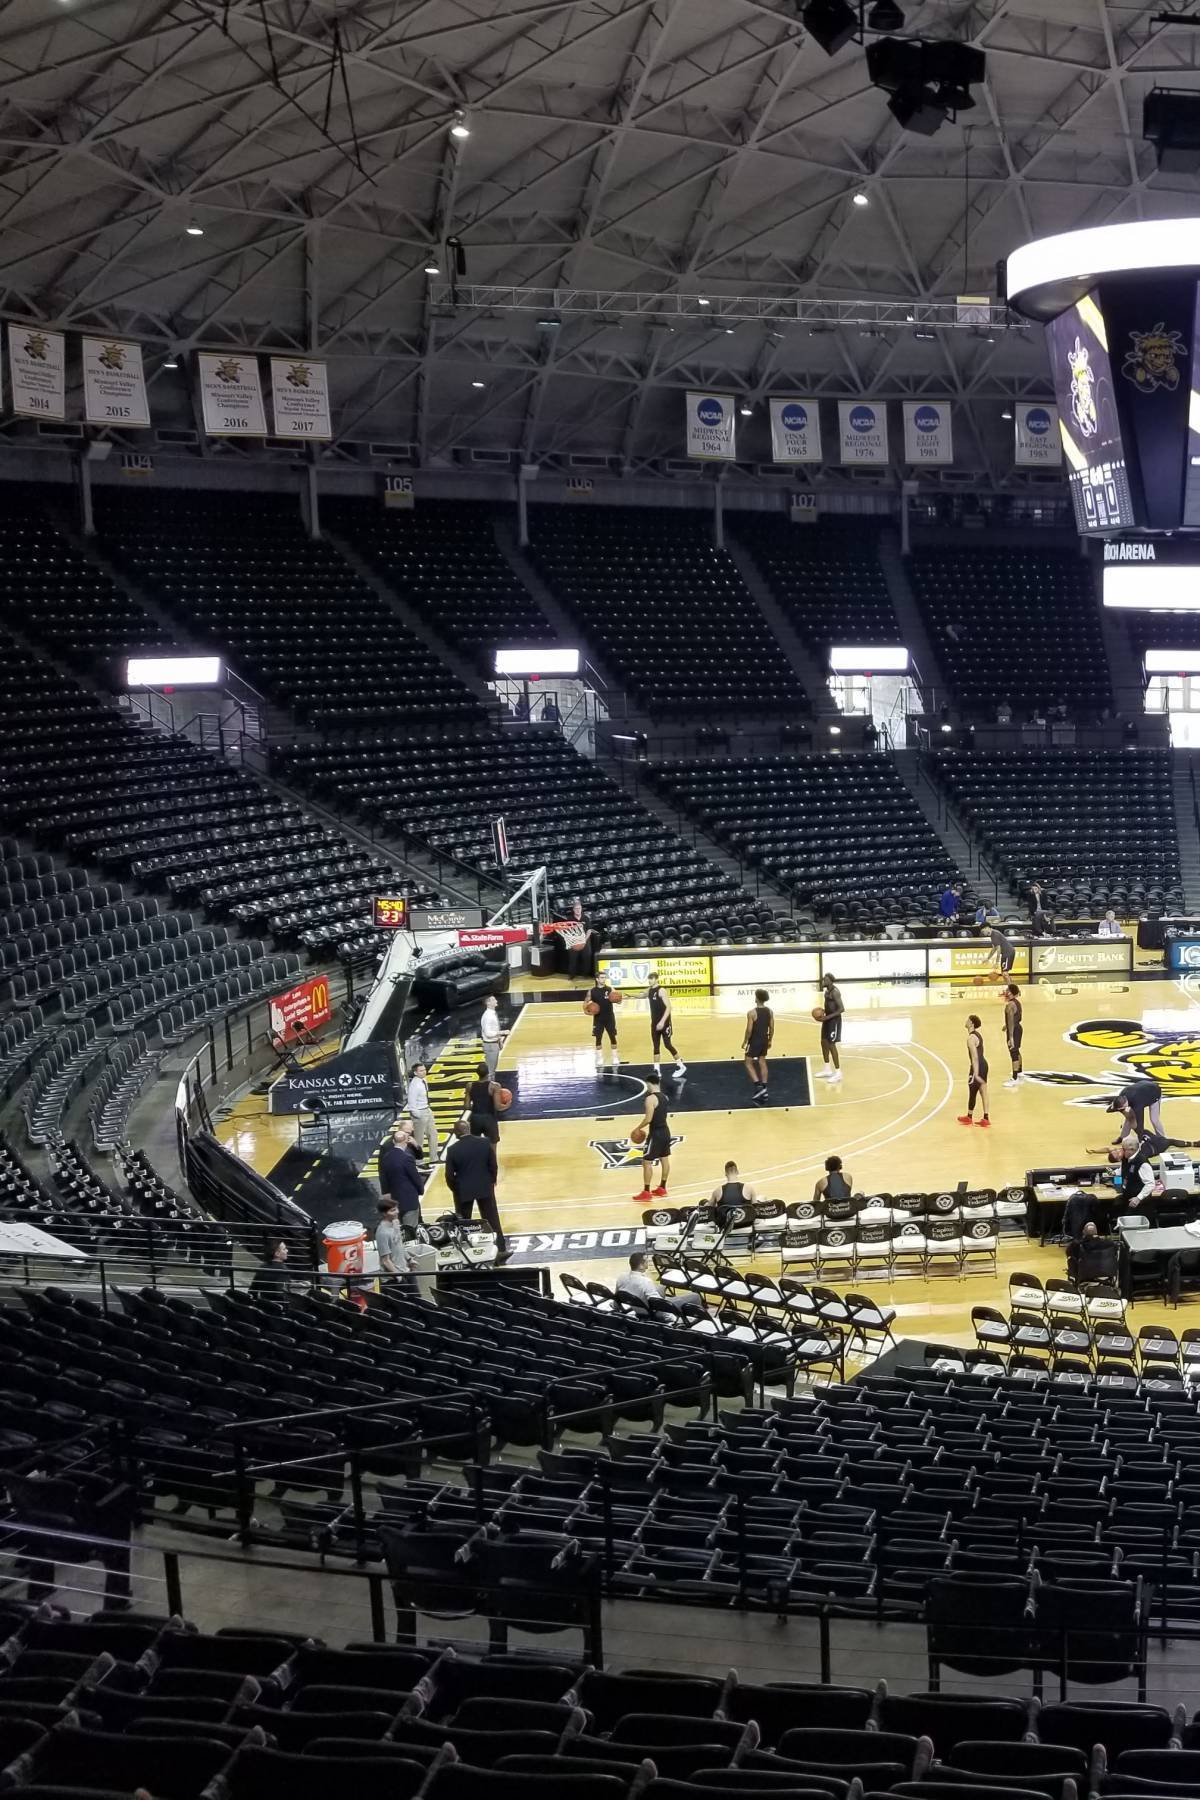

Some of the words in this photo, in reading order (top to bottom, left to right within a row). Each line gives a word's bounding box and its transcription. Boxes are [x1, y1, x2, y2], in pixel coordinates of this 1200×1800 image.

[29, 397, 49, 409] 2014
[105, 406, 130, 417] 2015
[699, 411, 722, 419] NCAA
[224, 417, 248, 428] 2016
[784, 416, 806, 424] NCAA
[852, 418, 875, 426] NCAA
[292, 421, 314, 431] 2017
[694, 427, 727, 435] MIDWEST
[692, 433, 729, 442] REGIONAL
[702, 442, 721, 451] 1964
[787, 447, 807, 456] 1965
[855, 448, 874, 457] 1976
[920, 448, 938, 457] 1981
[386, 477, 413, 491] 105
[792, 494, 816, 507] 107
[1119, 543, 1156, 561] ARENA
[377, 900, 403, 911] 45:40
[381, 911, 399, 922] 23
[1058, 954, 1093, 964] EQUITY
[1097, 951, 1125, 962] BANK
[657, 968, 707, 976] BlueShield
[289, 1078, 336, 1089] KANSAS
[354, 1074, 386, 1085] STAR
[968, 1193, 988, 1201] Capitol
[968, 1198, 989, 1206] Federal
[785, 1234, 808, 1242] Capitol
[932, 1231, 954, 1239] Federal
